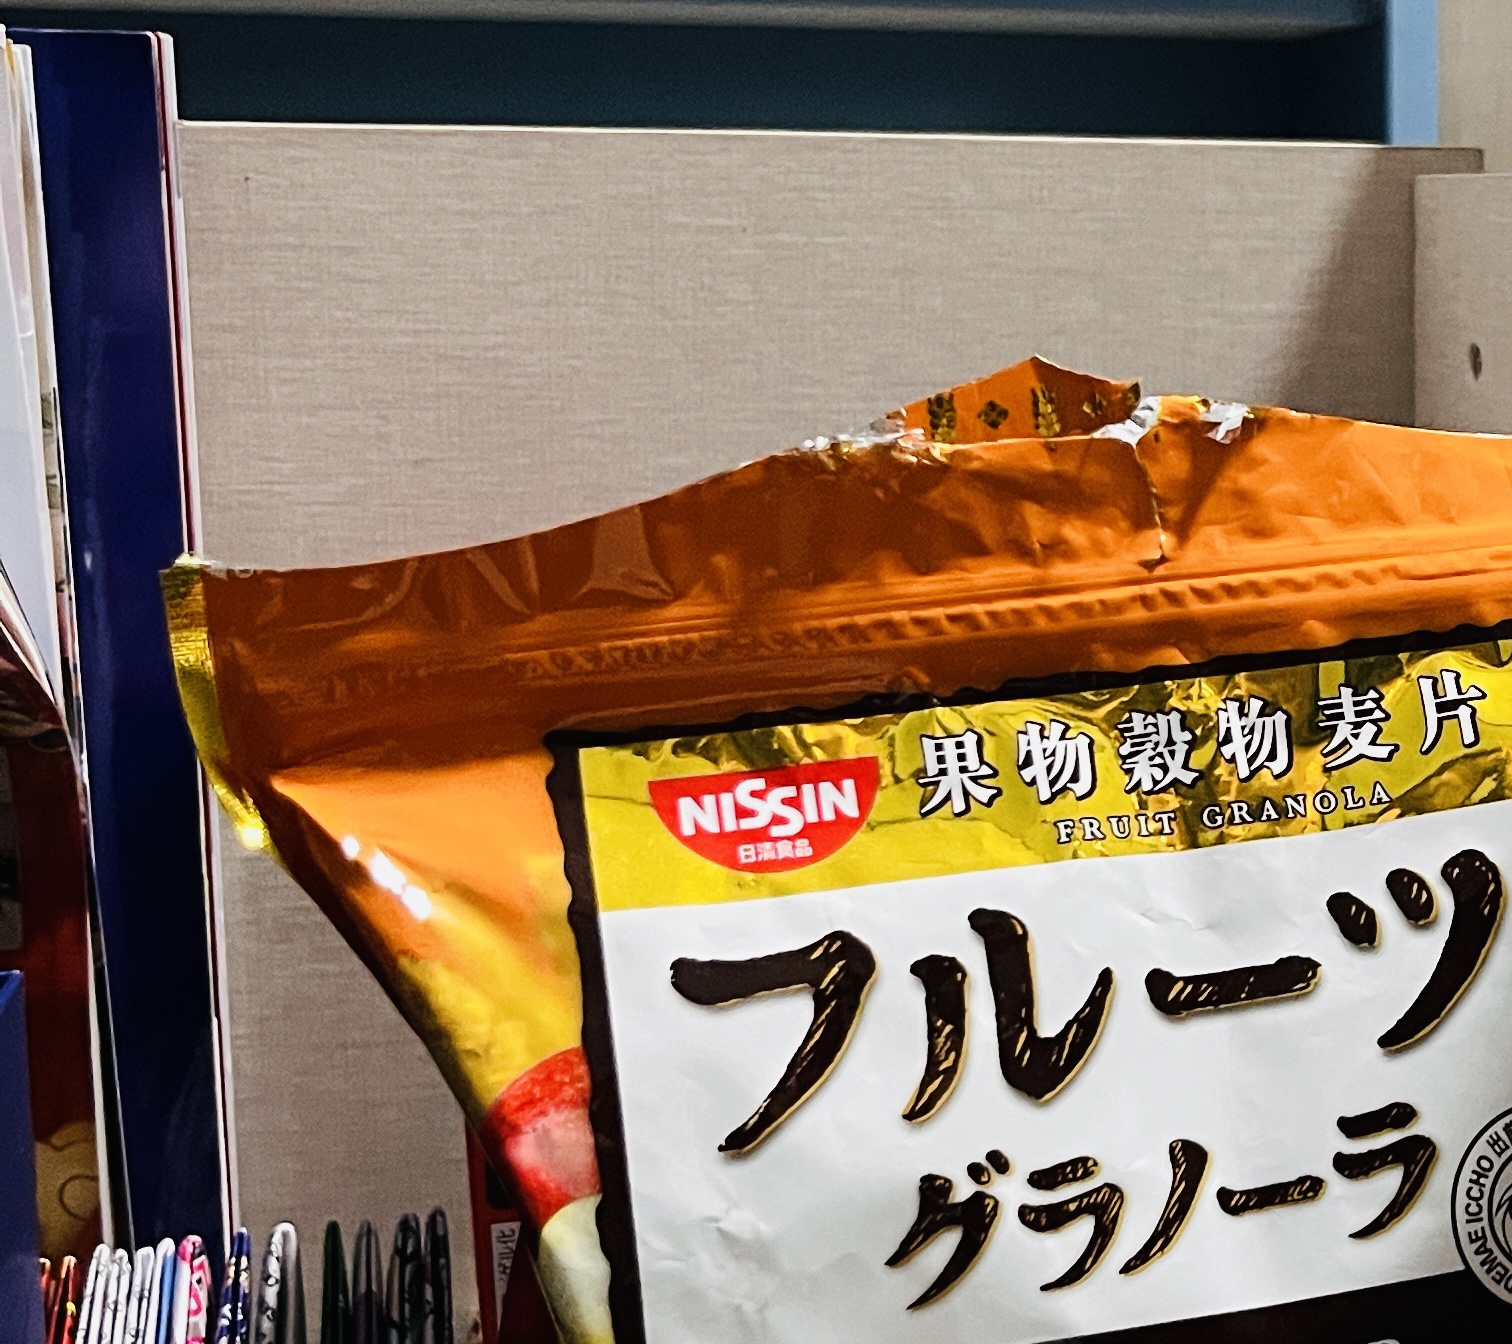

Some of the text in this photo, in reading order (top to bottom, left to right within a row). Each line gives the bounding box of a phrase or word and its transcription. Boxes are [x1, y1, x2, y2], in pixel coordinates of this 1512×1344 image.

[918, 669, 1487, 817] 果物穀物麦片
[677, 778, 859, 836] NISSIN
[1058, 781, 1393, 844] FRUIT GRANOLA
[737, 839, 813, 864] 日清食品
[670, 849, 1508, 1157] フルーツ
[884, 1103, 1442, 1311] グラノーラ
[1465, 1155, 1494, 1224] ICCHO
